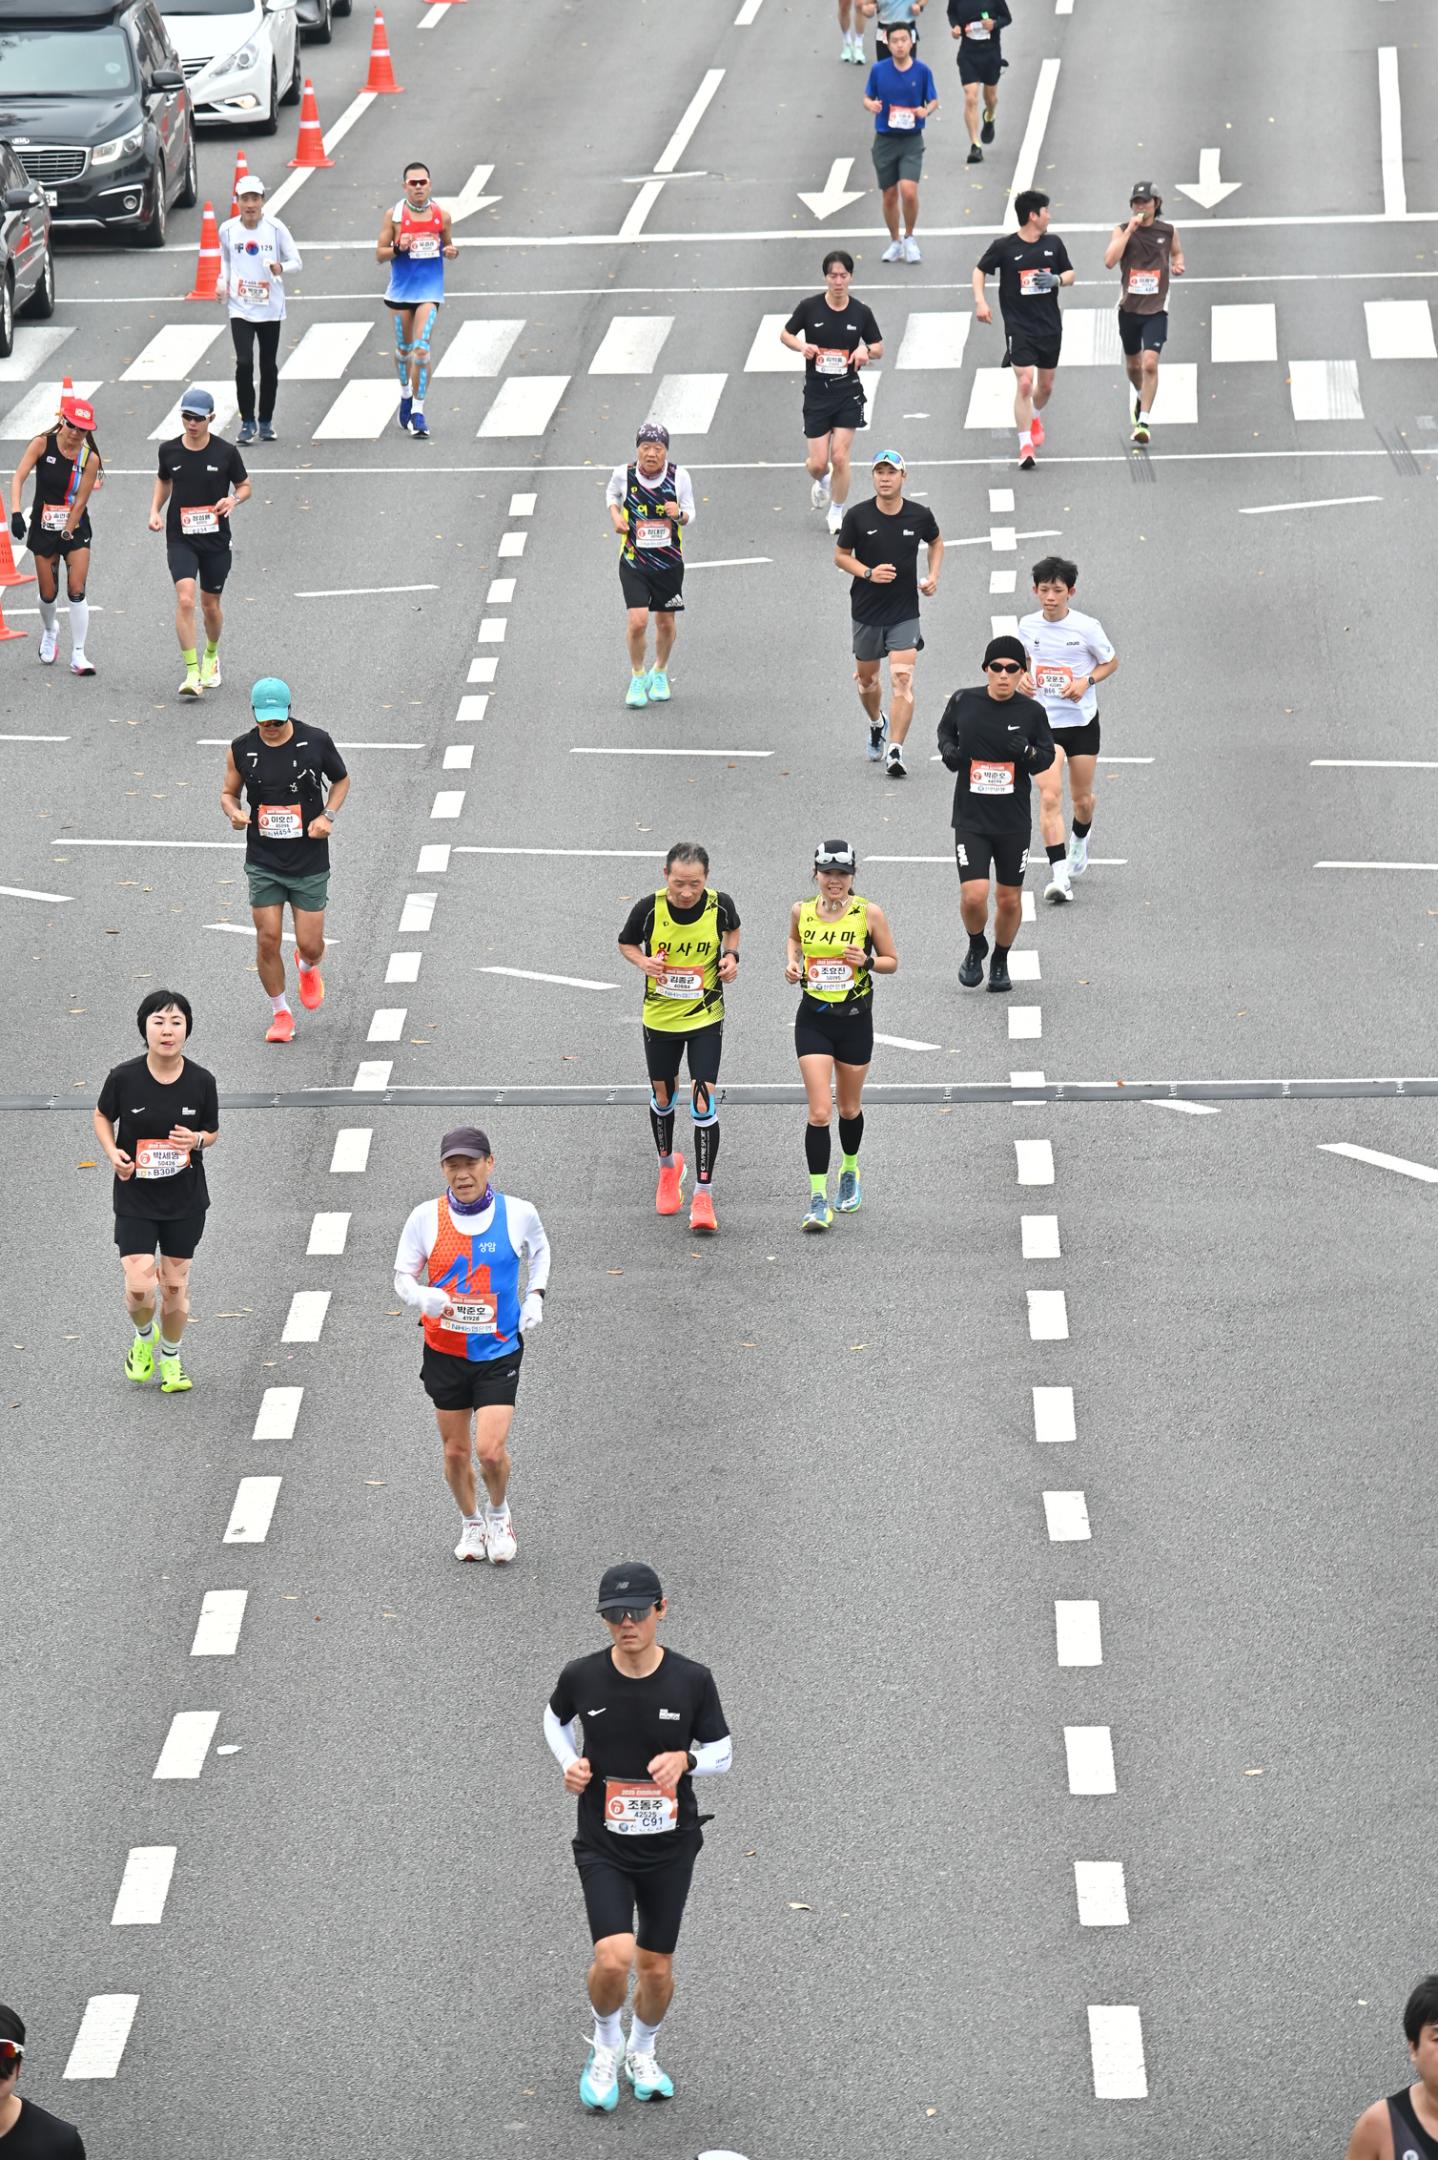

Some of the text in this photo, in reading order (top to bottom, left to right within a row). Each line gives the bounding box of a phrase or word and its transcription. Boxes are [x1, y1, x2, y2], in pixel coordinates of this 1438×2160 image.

[803, 929, 856, 945] 인사마
[478, 1241, 497, 1253] 상암
[642, 1817, 663, 1826] C91
